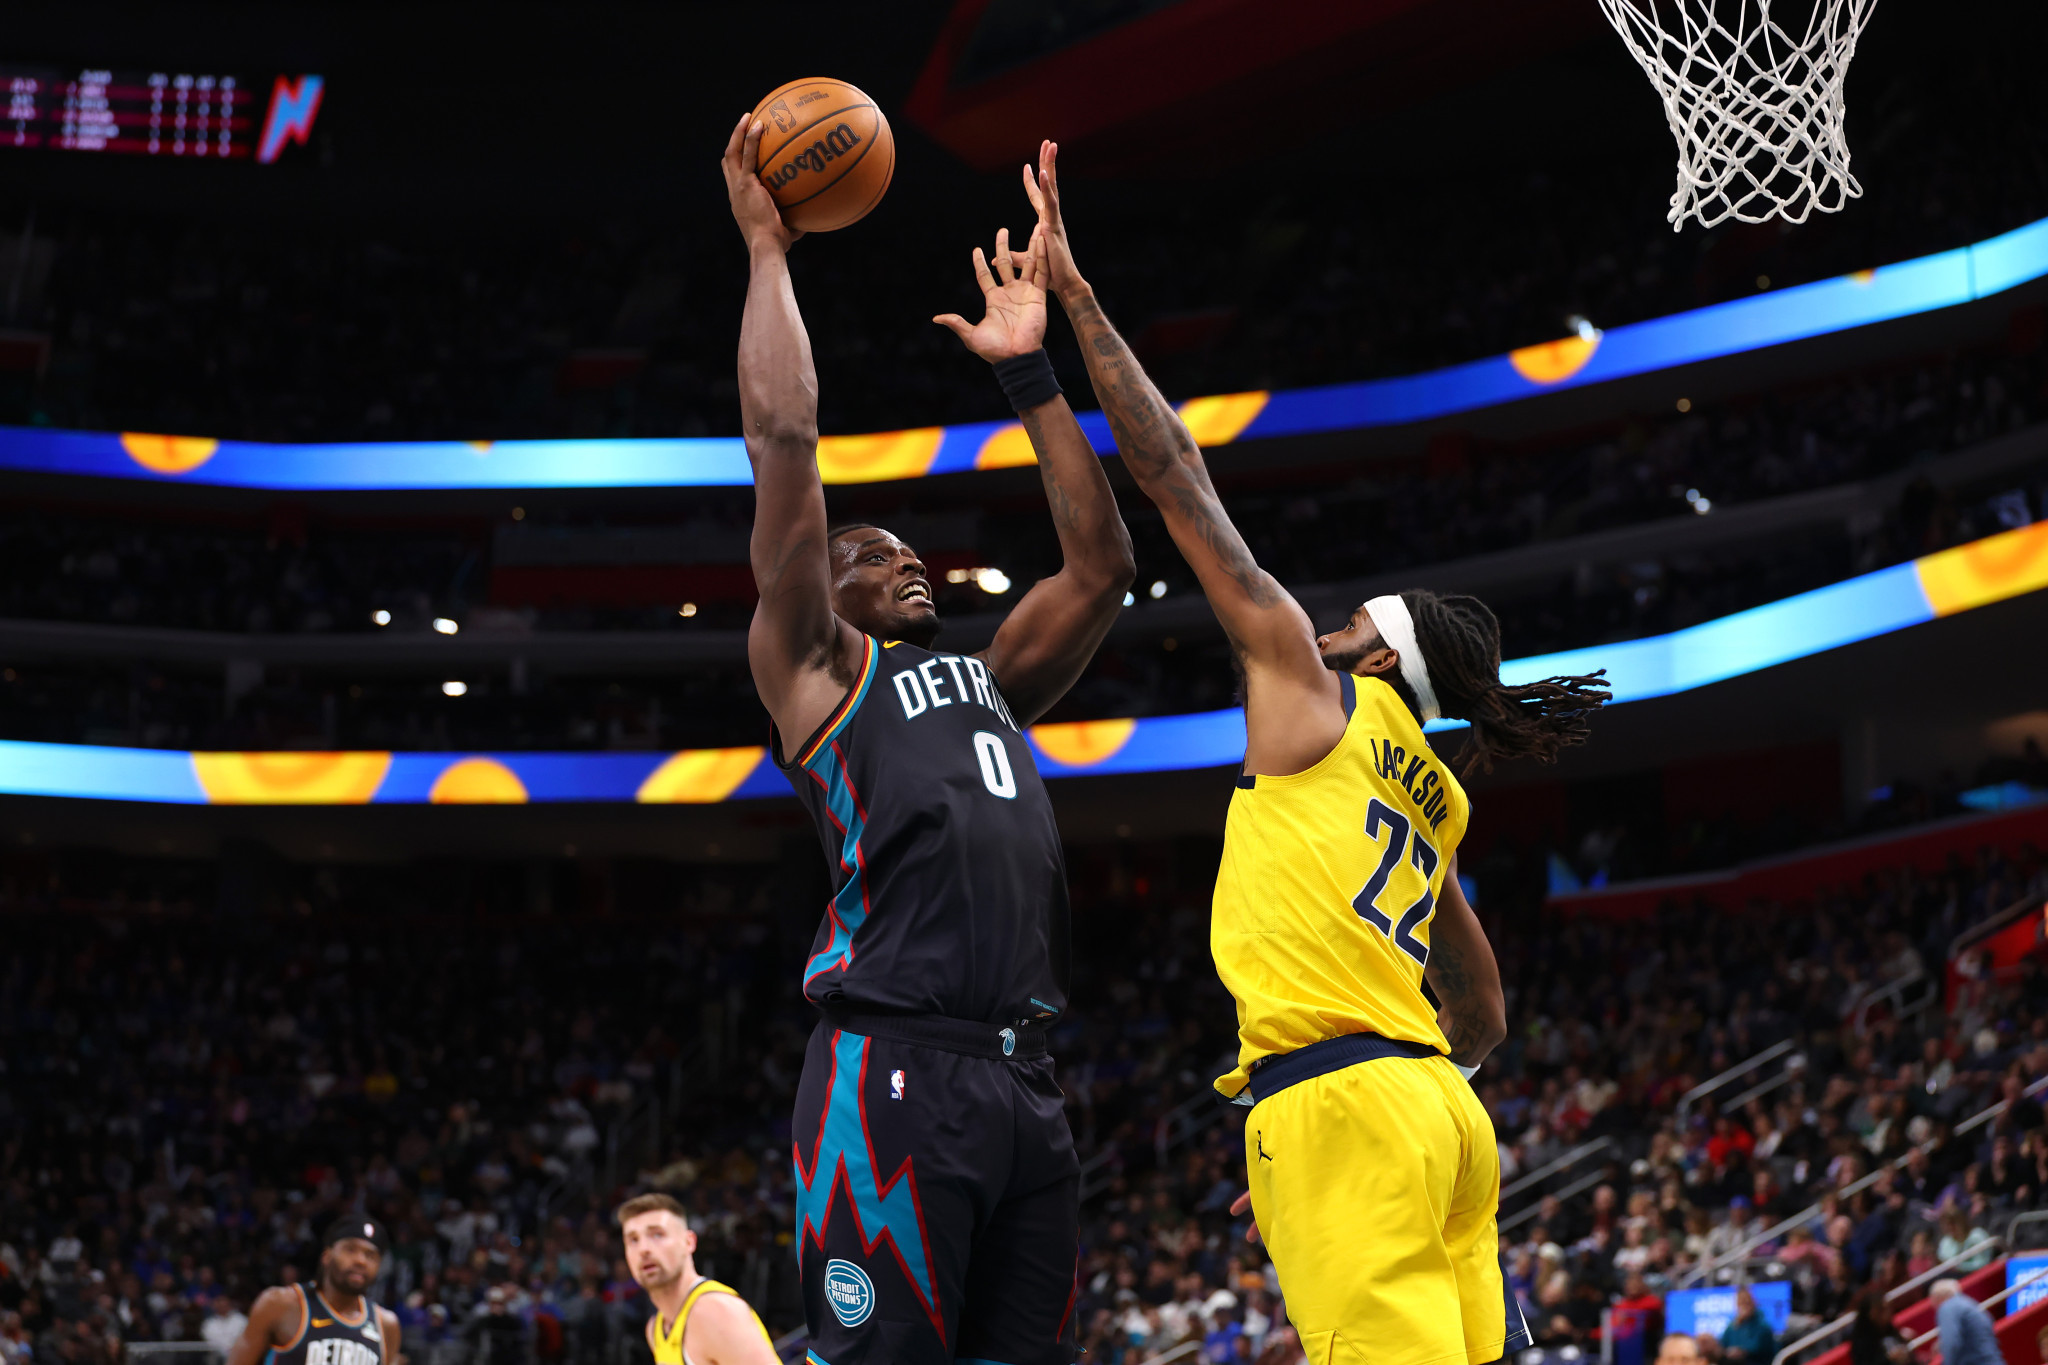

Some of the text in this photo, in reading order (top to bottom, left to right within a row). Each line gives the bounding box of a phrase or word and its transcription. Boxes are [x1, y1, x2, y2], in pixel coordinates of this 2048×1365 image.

[766, 123, 862, 191] Wilson
[972, 730, 1018, 800] 0
[1370, 738, 1448, 834] JACKSON
[1352, 796, 1440, 969] 22
[830, 1279, 860, 1295] DETROIT
[831, 1290, 861, 1305] PISTONS
